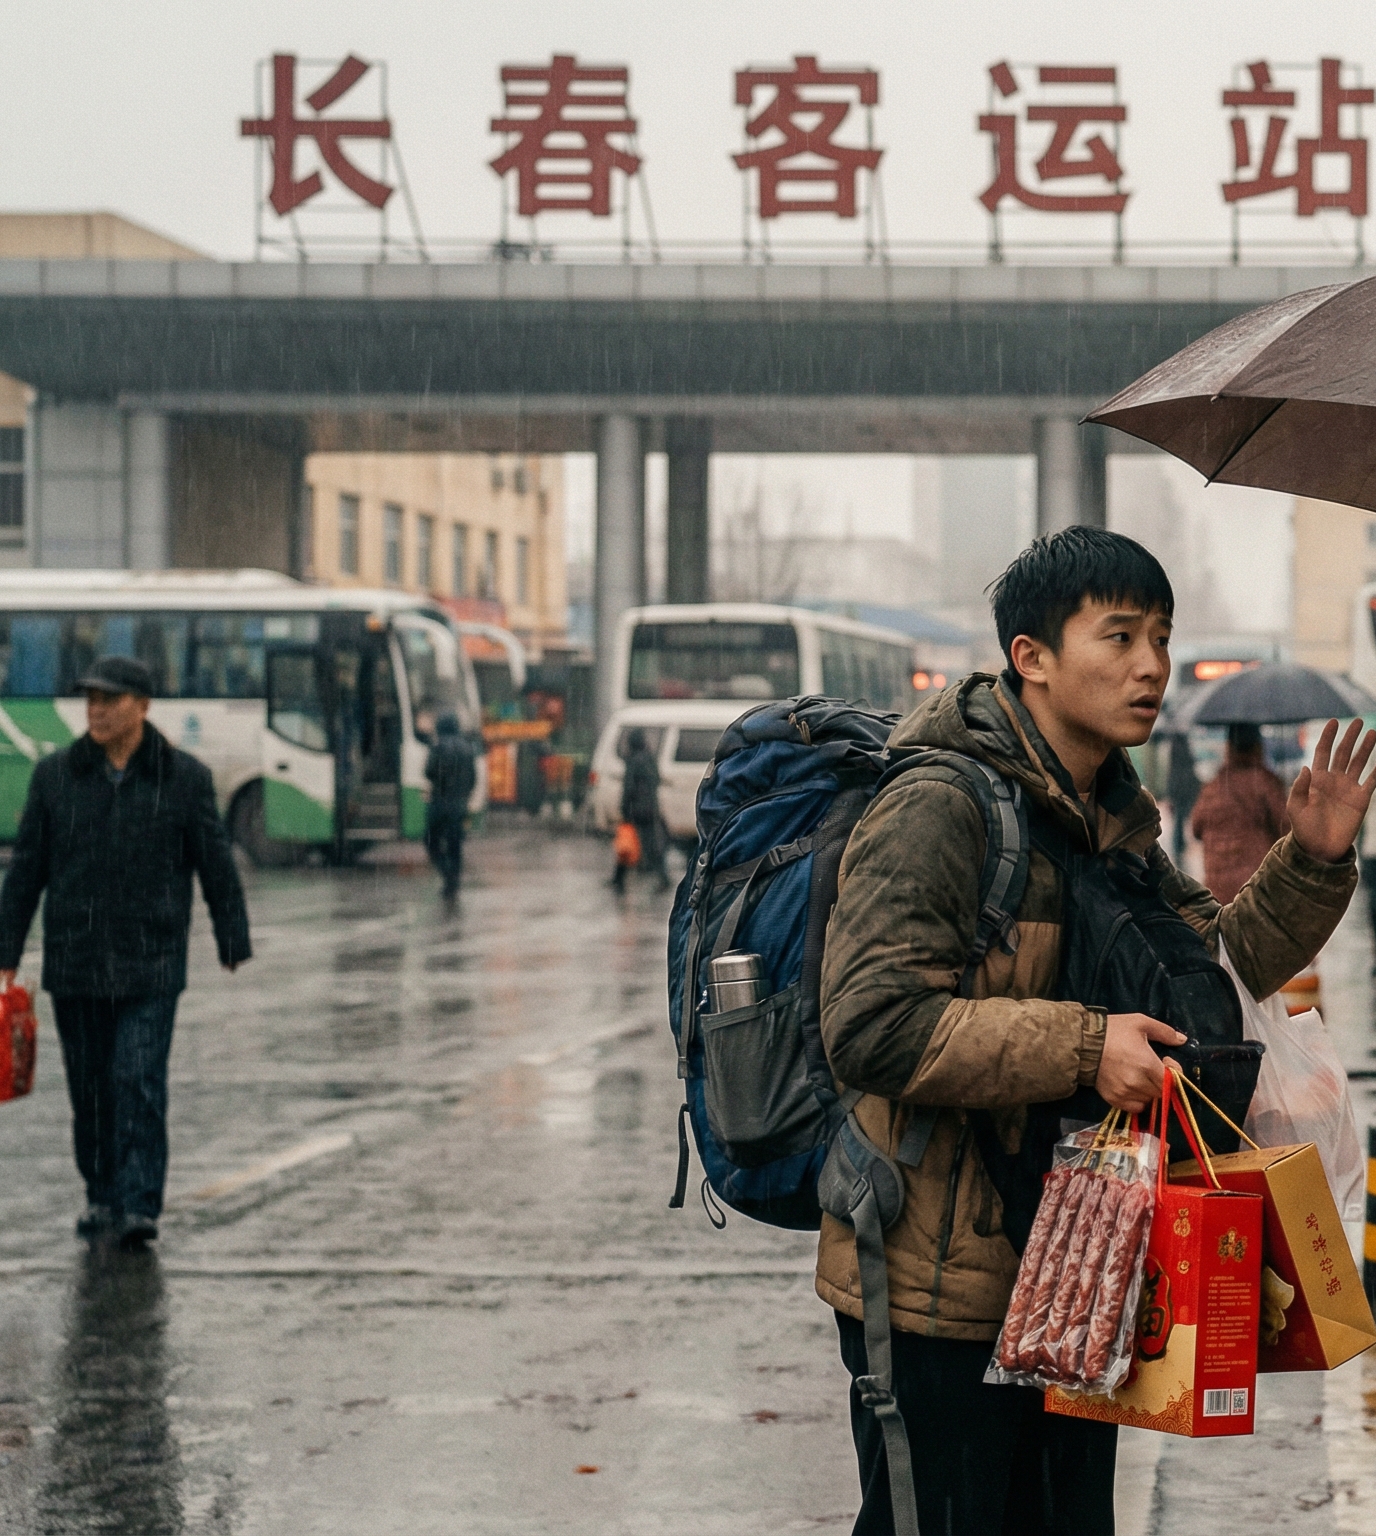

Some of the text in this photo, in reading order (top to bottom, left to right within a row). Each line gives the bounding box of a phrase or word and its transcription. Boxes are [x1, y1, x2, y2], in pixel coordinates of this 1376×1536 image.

[239, 52, 1376, 218] 长春客运站
